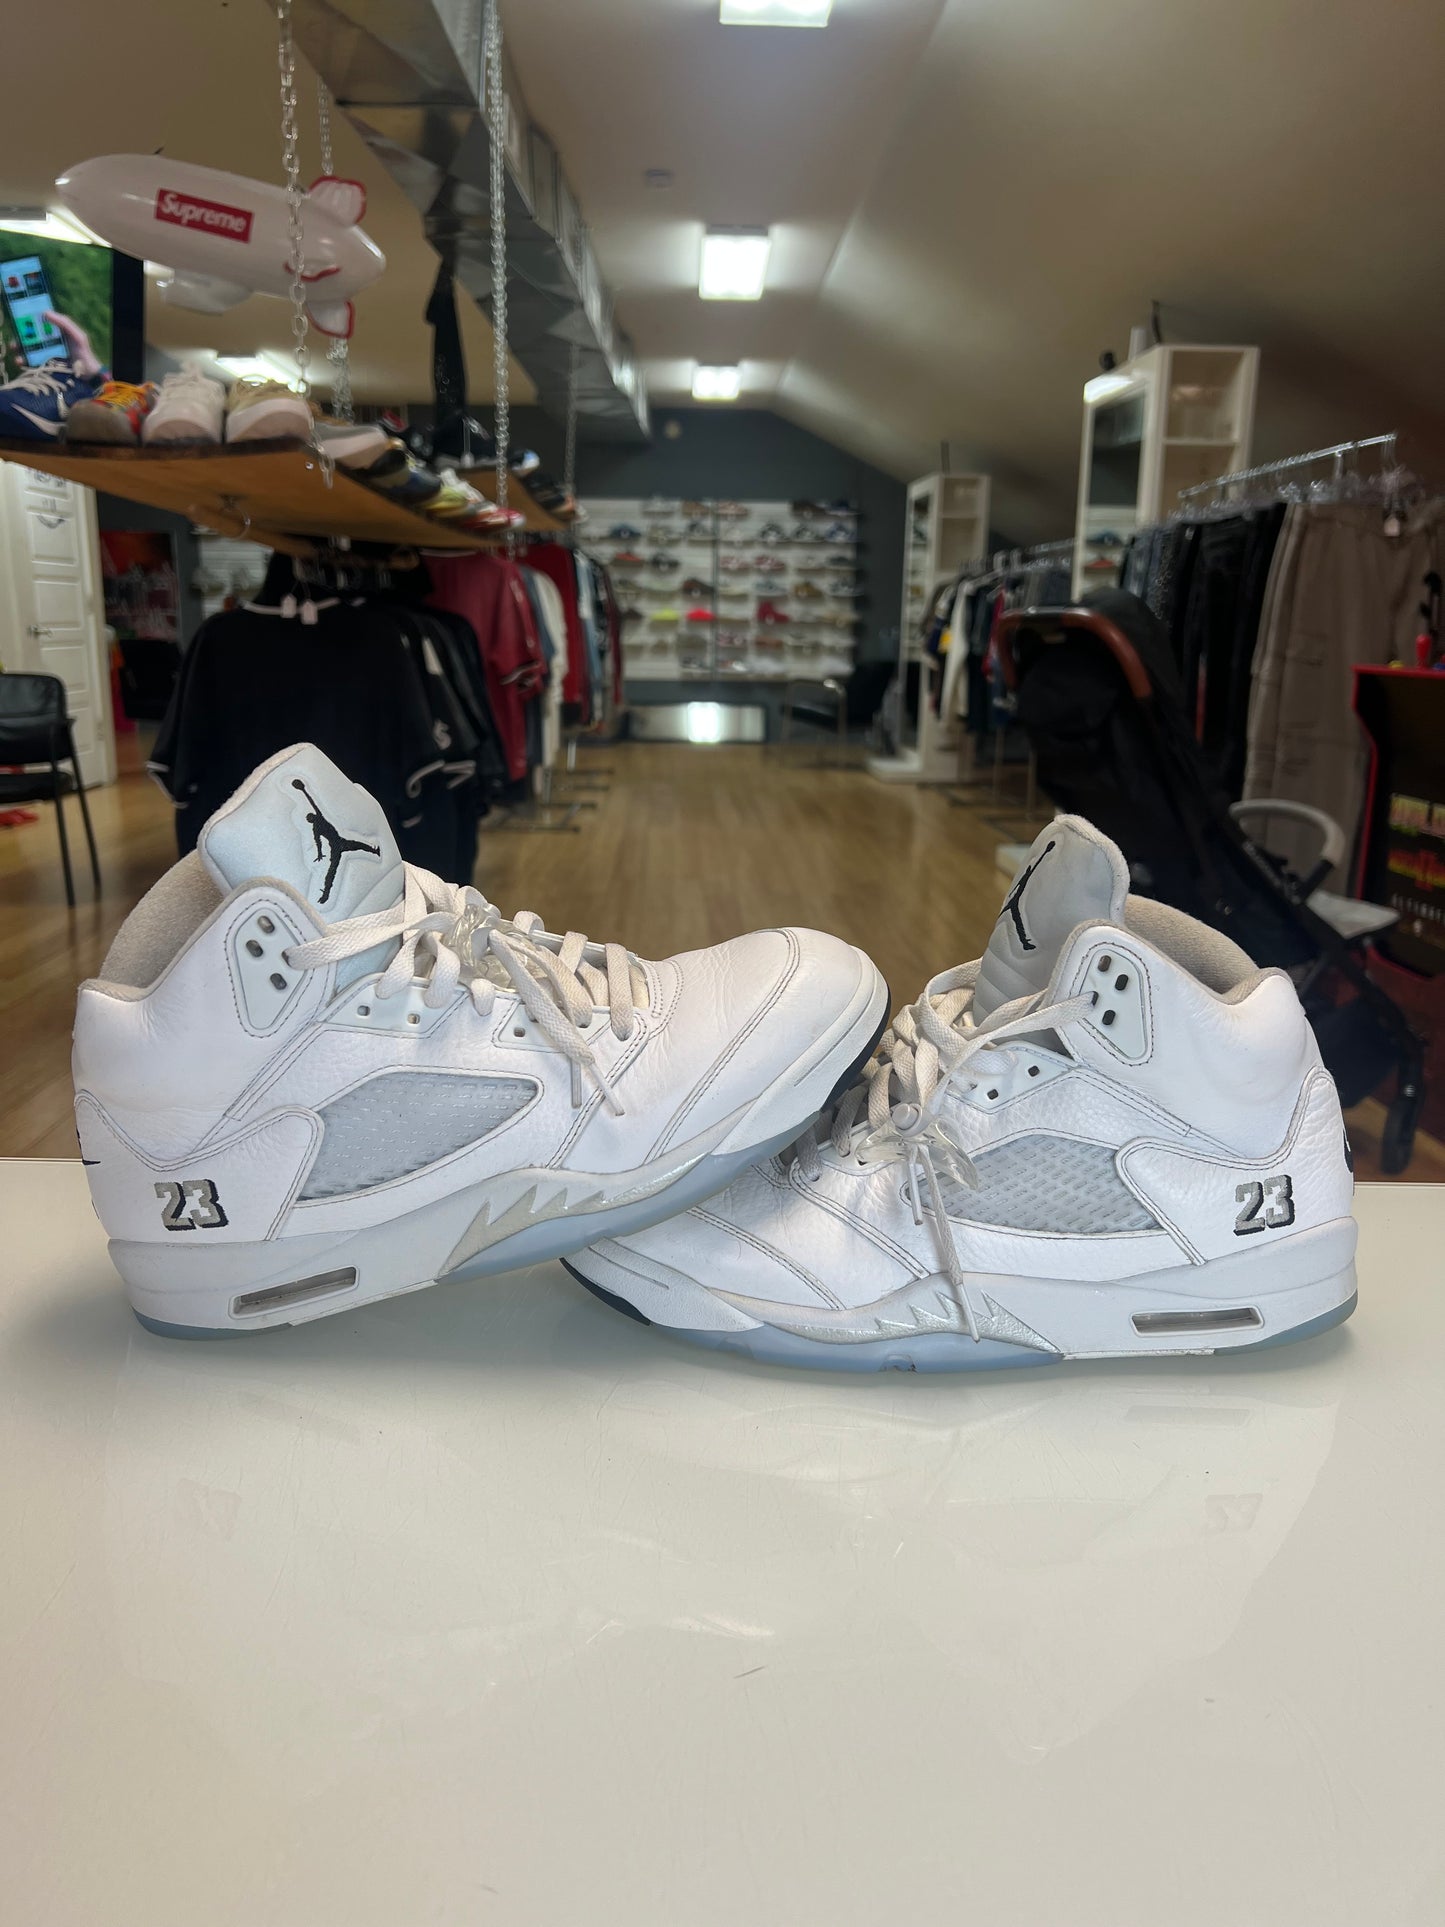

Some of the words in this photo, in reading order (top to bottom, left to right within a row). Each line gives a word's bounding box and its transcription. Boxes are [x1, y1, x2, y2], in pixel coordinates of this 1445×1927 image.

[161, 193, 247, 233] Supreme
[154, 1179, 229, 1231] 23
[1233, 1174, 1295, 1237] 23
